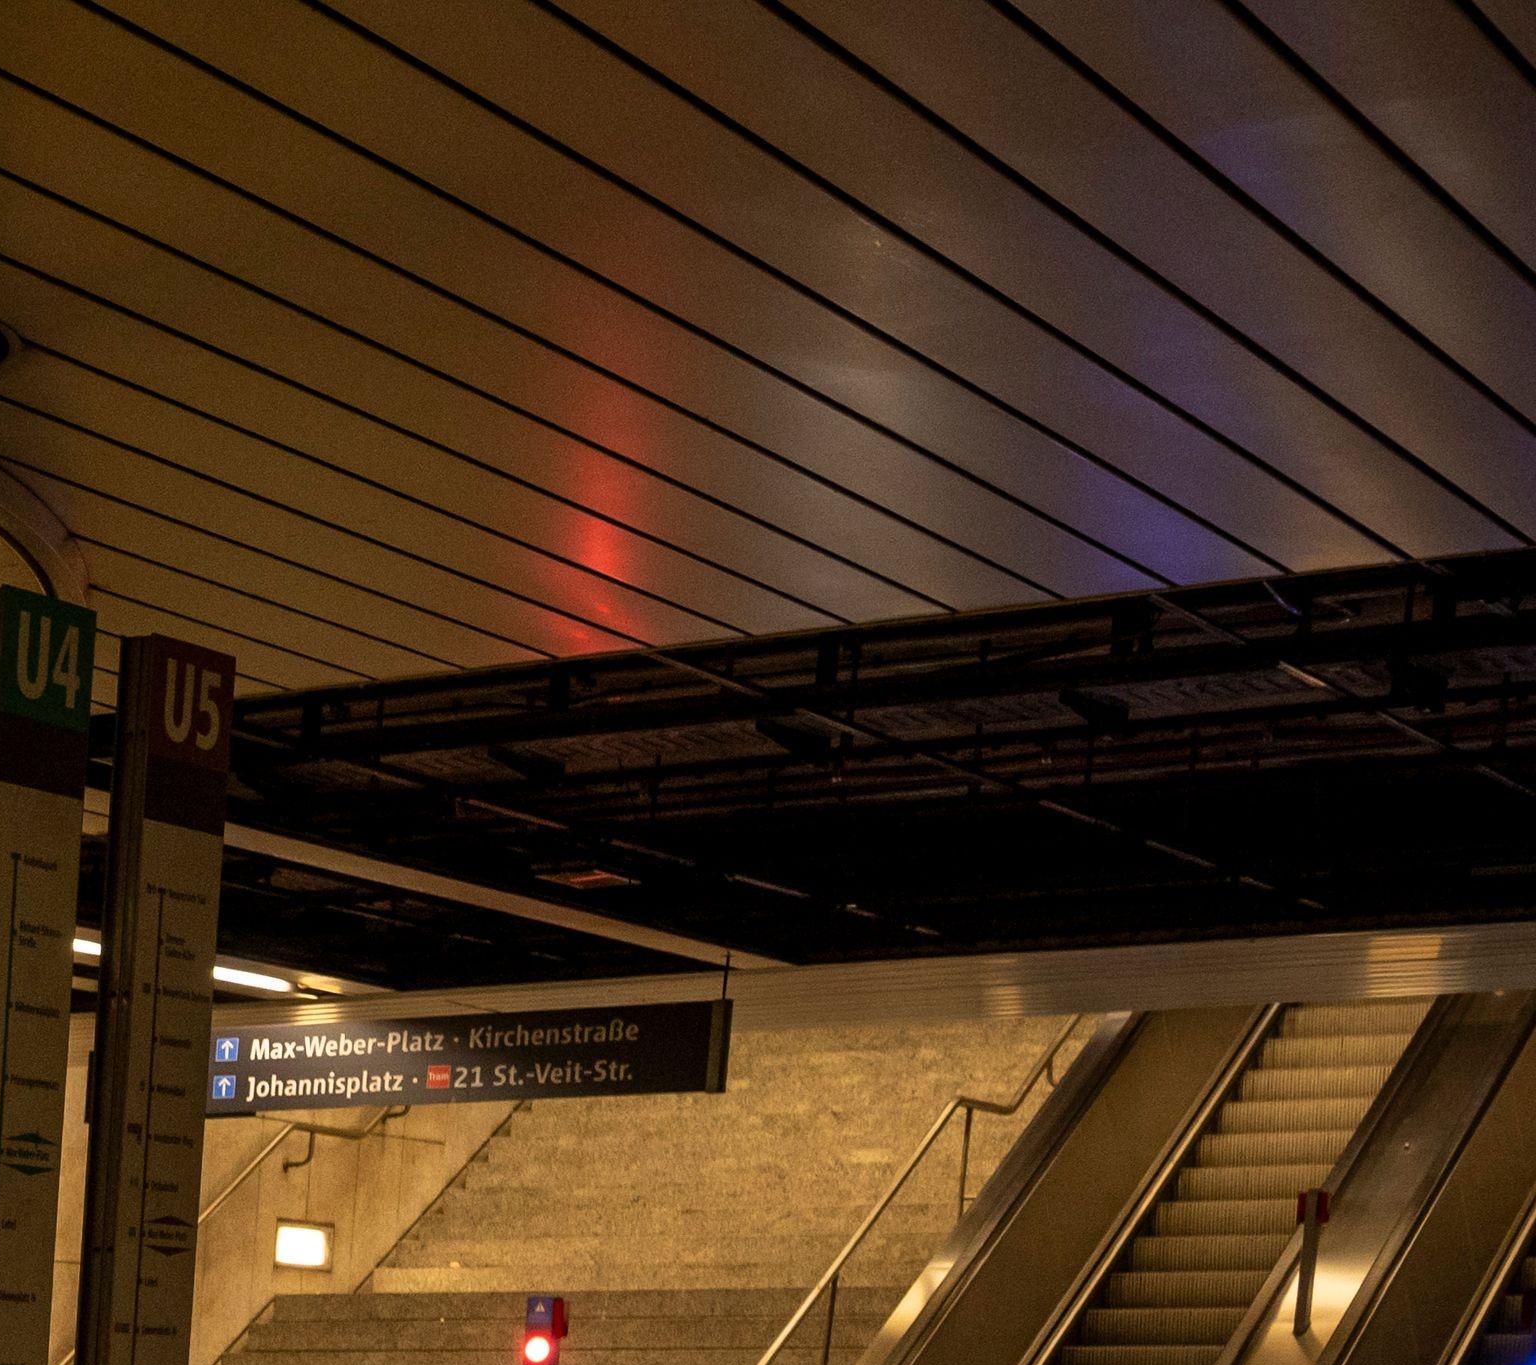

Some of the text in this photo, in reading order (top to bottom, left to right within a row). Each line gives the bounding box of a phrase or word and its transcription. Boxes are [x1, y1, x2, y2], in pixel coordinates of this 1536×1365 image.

[16, 611, 81, 710] U4
[164, 657, 222, 751] U5
[249, 1018, 640, 1061] Max-Weber-Platz Kirchenstraße
[245, 1059, 633, 1102] Johannisplatz Tram 21 St.-Veit-Str.
